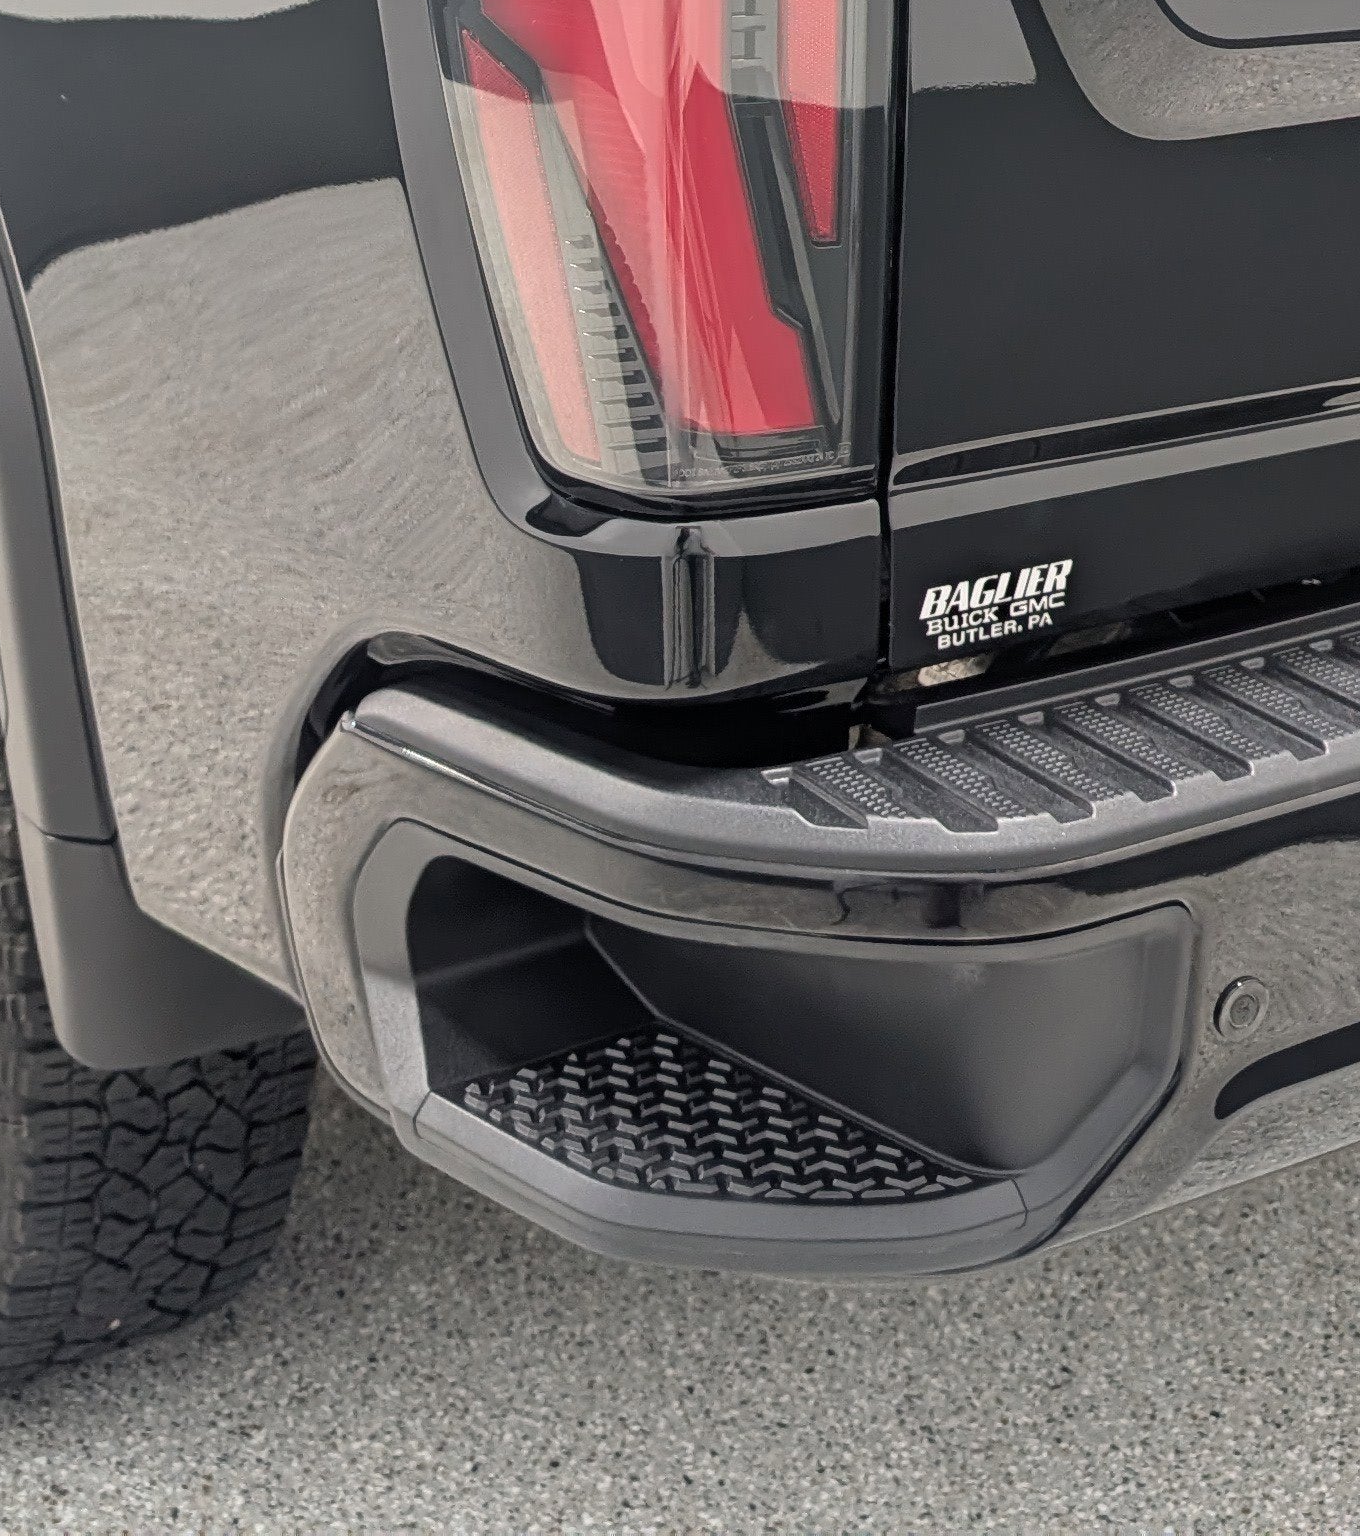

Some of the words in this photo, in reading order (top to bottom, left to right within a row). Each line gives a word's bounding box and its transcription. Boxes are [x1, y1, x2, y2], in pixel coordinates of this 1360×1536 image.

[919, 559, 1073, 620] BAGLIER
[926, 605, 999, 636] BUICK
[1009, 592, 1065, 617] GMC
[1028, 612, 1054, 630] PA
